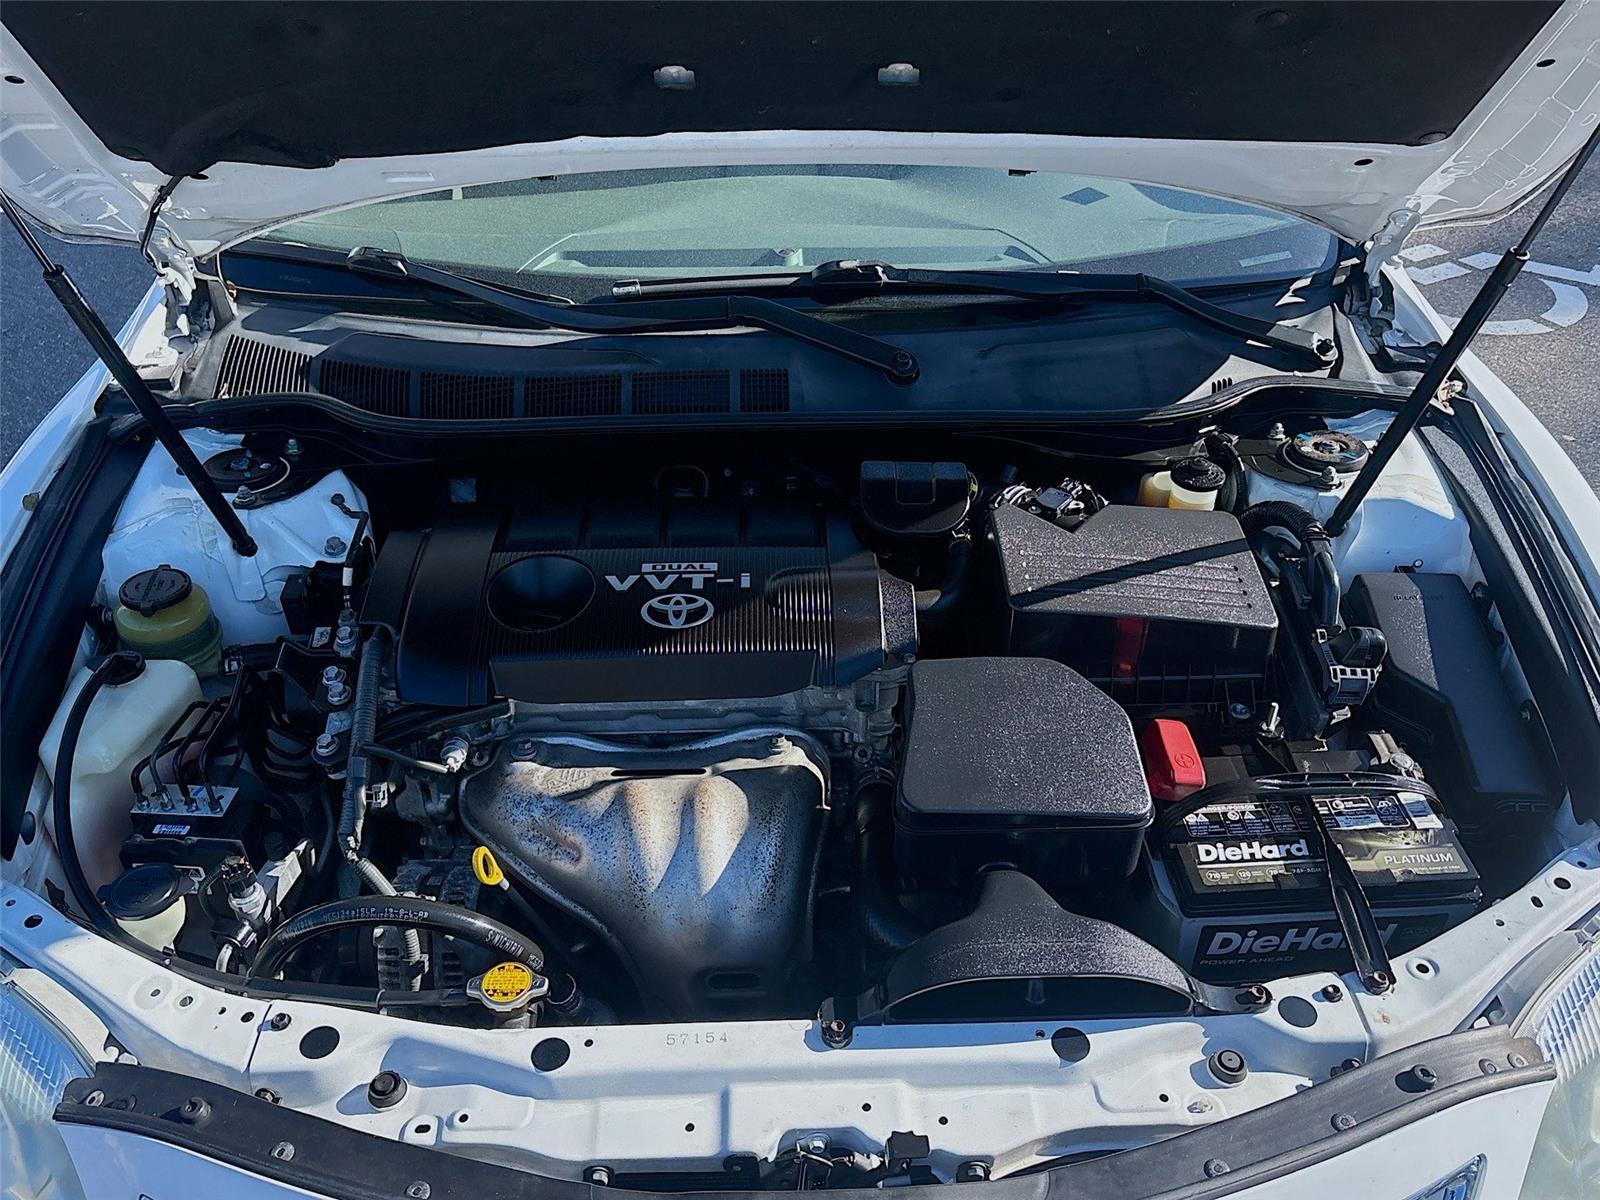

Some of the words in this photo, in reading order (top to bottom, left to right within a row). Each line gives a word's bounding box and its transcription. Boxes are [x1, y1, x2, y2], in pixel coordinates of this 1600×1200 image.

[651, 563, 711, 571] DUAL
[605, 573, 751, 591] VVT-i
[1197, 839, 1309, 862] DieHard
[1383, 852, 1454, 865] PLATINUM
[1207, 923, 1399, 955] DieHad
[1199, 957, 1246, 966] POWER
[1249, 955, 1296, 964] AHEAD
[666, 1032, 728, 1046] 57154
